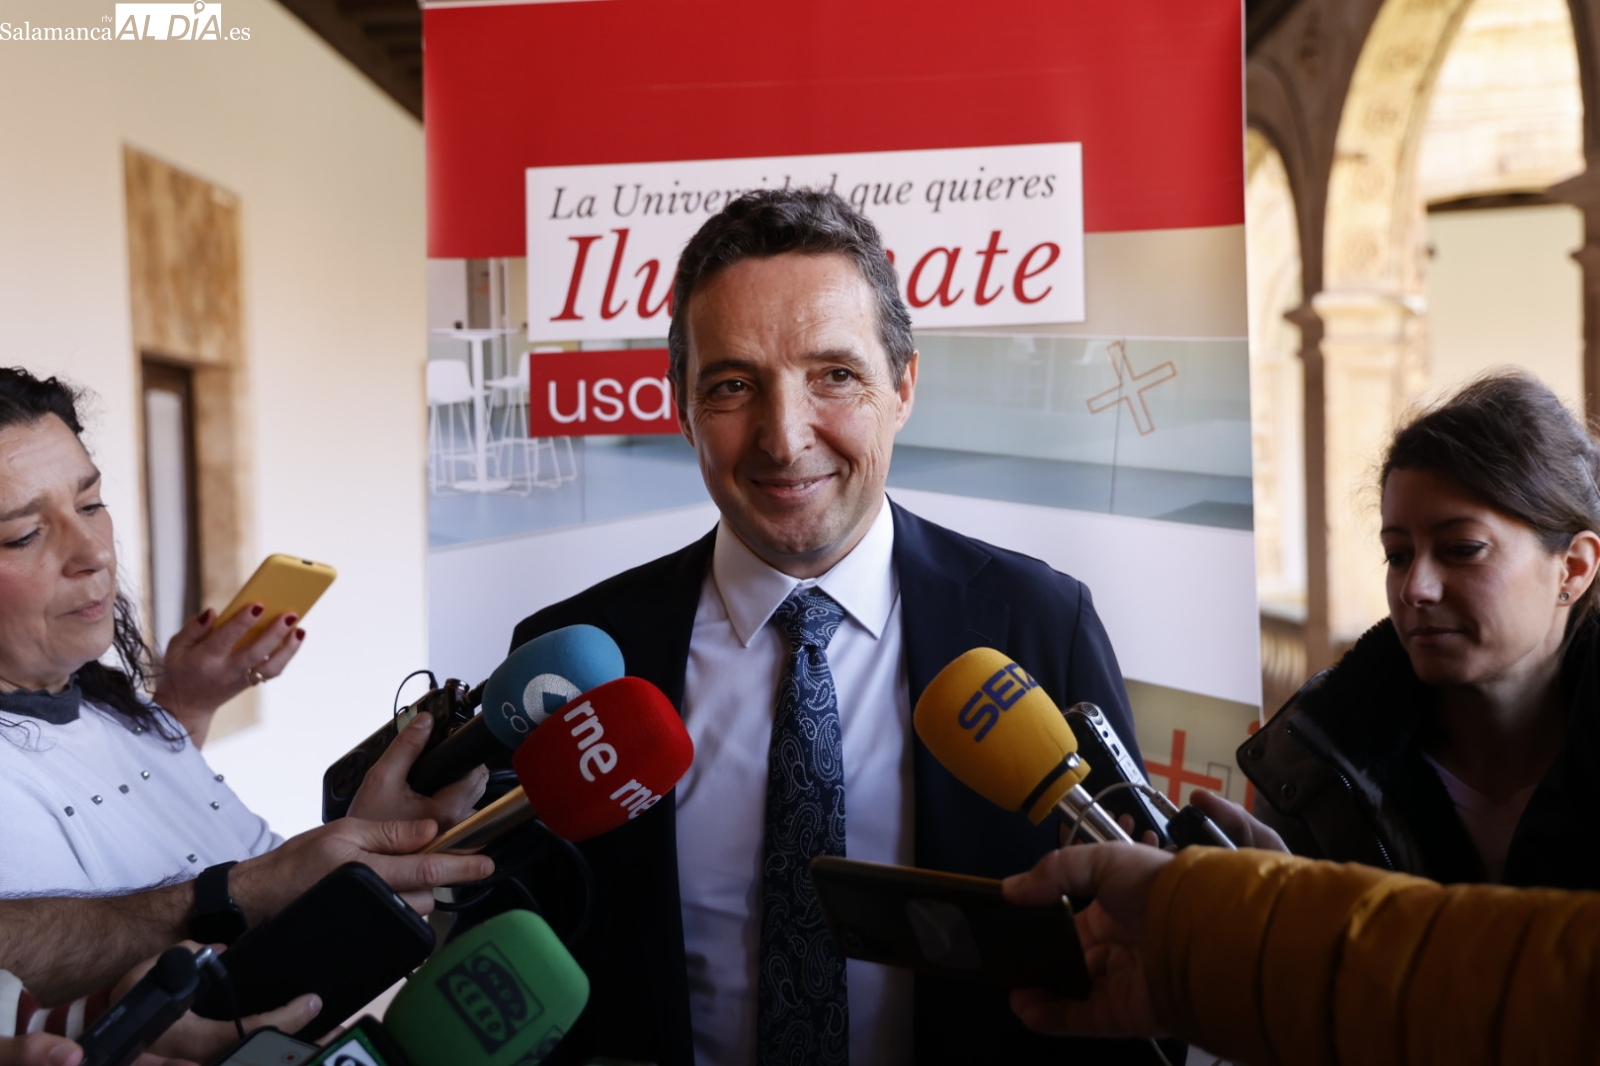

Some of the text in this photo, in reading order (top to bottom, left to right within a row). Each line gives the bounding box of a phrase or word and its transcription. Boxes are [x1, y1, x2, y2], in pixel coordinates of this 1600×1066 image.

[549, 186, 597, 220] La
[850, 180, 914, 215] que
[925, 167, 1057, 214] quieres
[550, 228, 1061, 321] Iluate
[548, 376, 672, 424] usa
[501, 702, 529, 734] CO
[563, 700, 618, 782] rne
[609, 778, 662, 820] rne
[455, 978, 502, 1034] CERO
